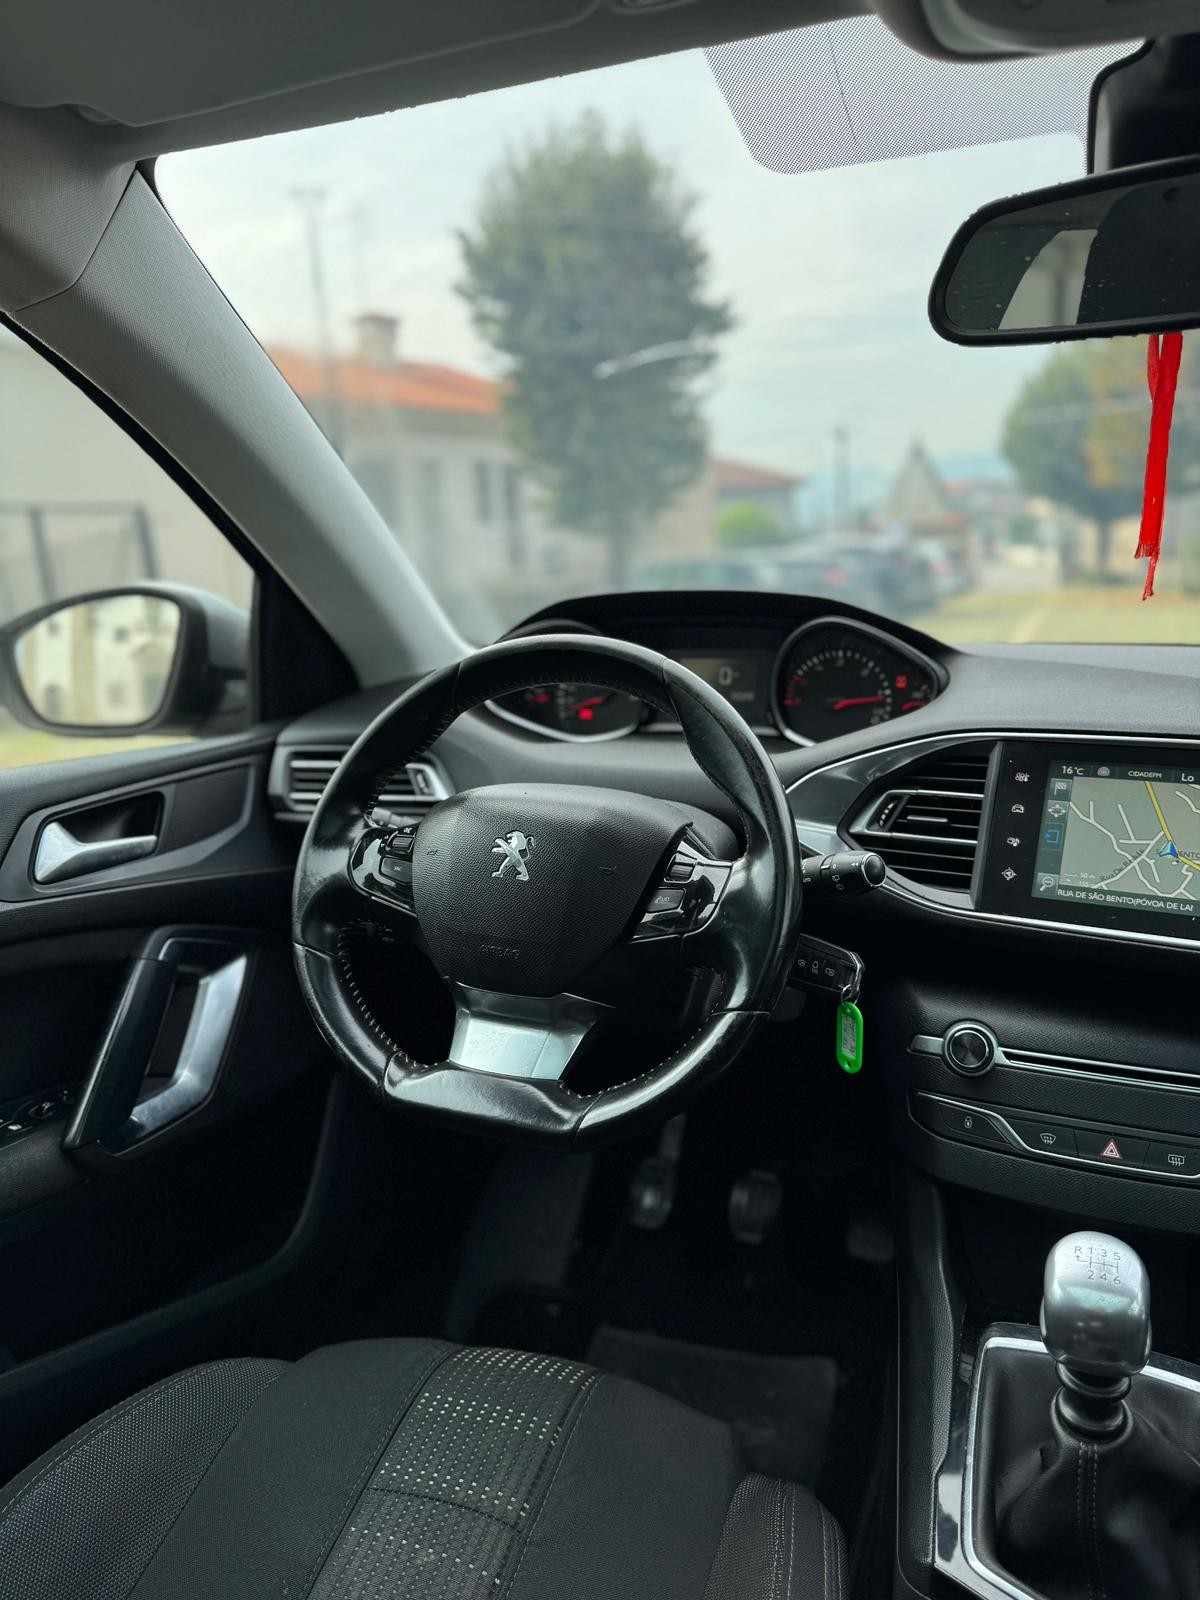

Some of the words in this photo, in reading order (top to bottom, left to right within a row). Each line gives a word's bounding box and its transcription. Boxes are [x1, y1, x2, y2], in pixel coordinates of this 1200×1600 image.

[1181, 773, 1194, 782] Lo
[1057, 889, 1073, 897] RUA
[1075, 891, 1087, 899] DE
[1088, 892, 1105, 901] SÃO
[1166, 902, 1179, 910] DE
[1075, 1247, 1082, 1255] R
[1101, 1249, 1107, 1257] 3
[1113, 1252, 1121, 1261] 5
[1088, 1270, 1095, 1280] 2
[1100, 1273, 1107, 1281] 4
[1113, 1276, 1121, 1285] 6
